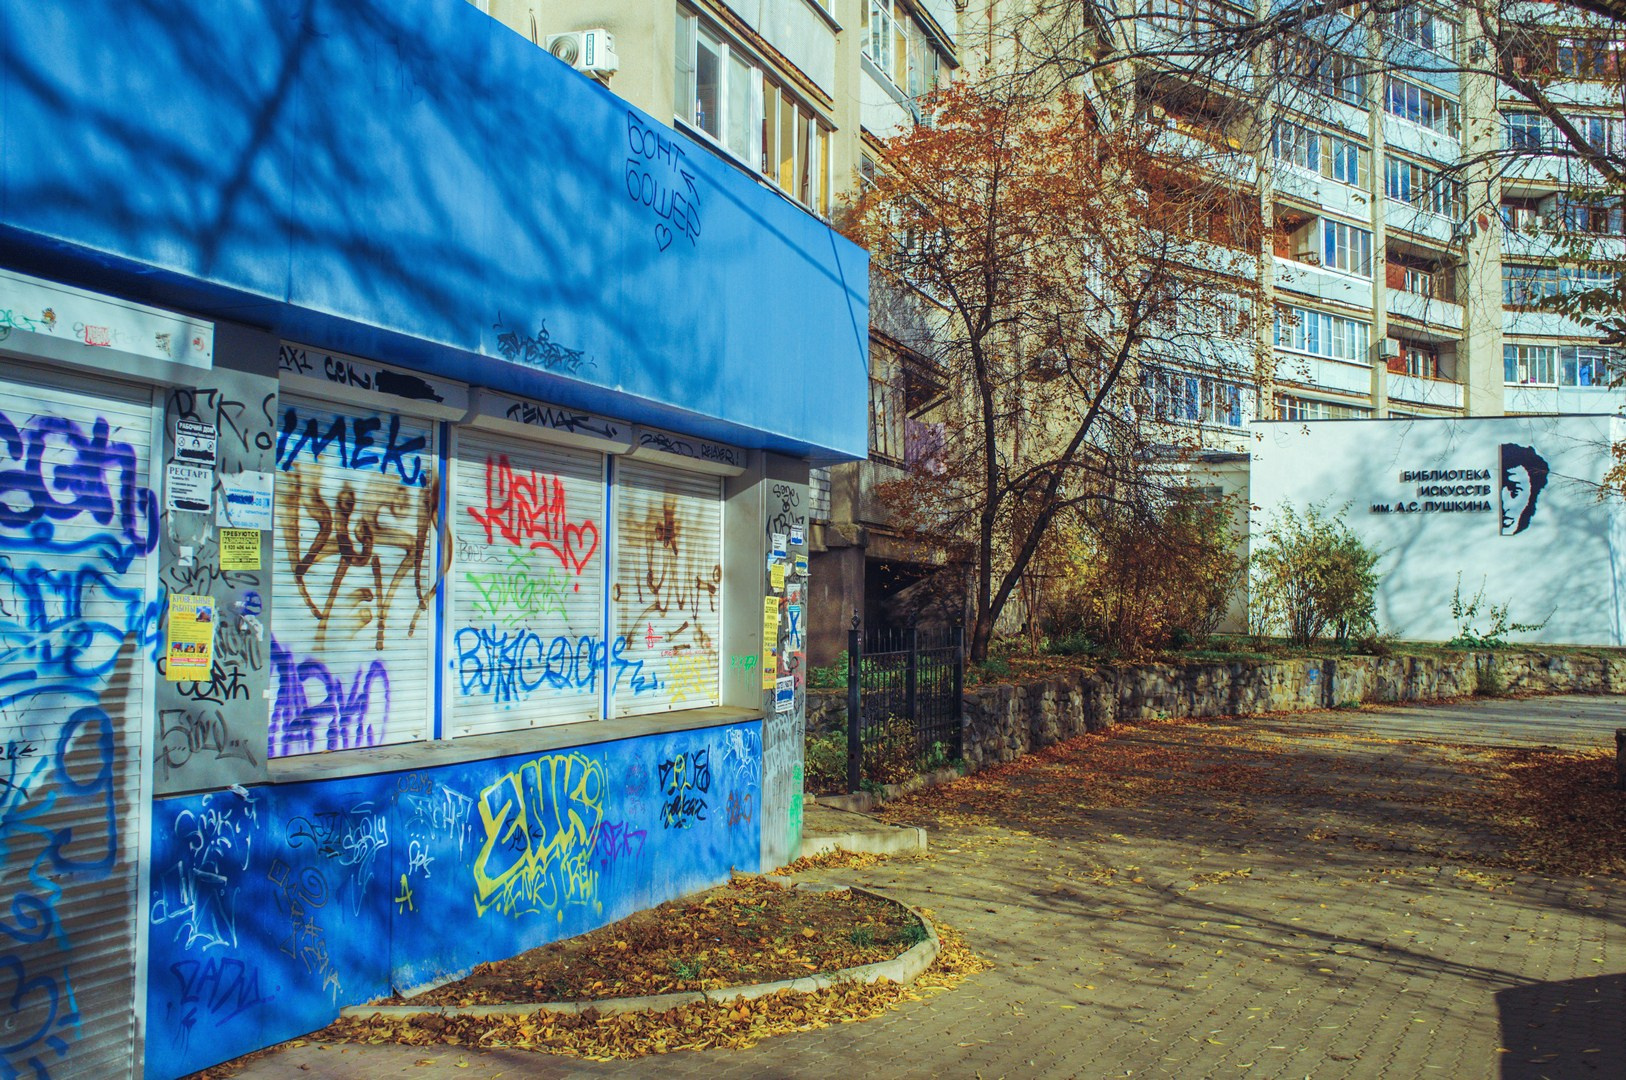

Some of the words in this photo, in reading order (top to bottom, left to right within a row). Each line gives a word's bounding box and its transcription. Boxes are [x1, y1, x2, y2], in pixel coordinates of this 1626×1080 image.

[169, 466, 209, 479] РЕСТАРТ
[1402, 469, 1491, 481] БИБЛИОТЕКА
[1419, 484, 1491, 497] ИСКУССТВ
[1398, 501, 1422, 513] А.С.
[1425, 500, 1492, 513] ПУШКИНА
